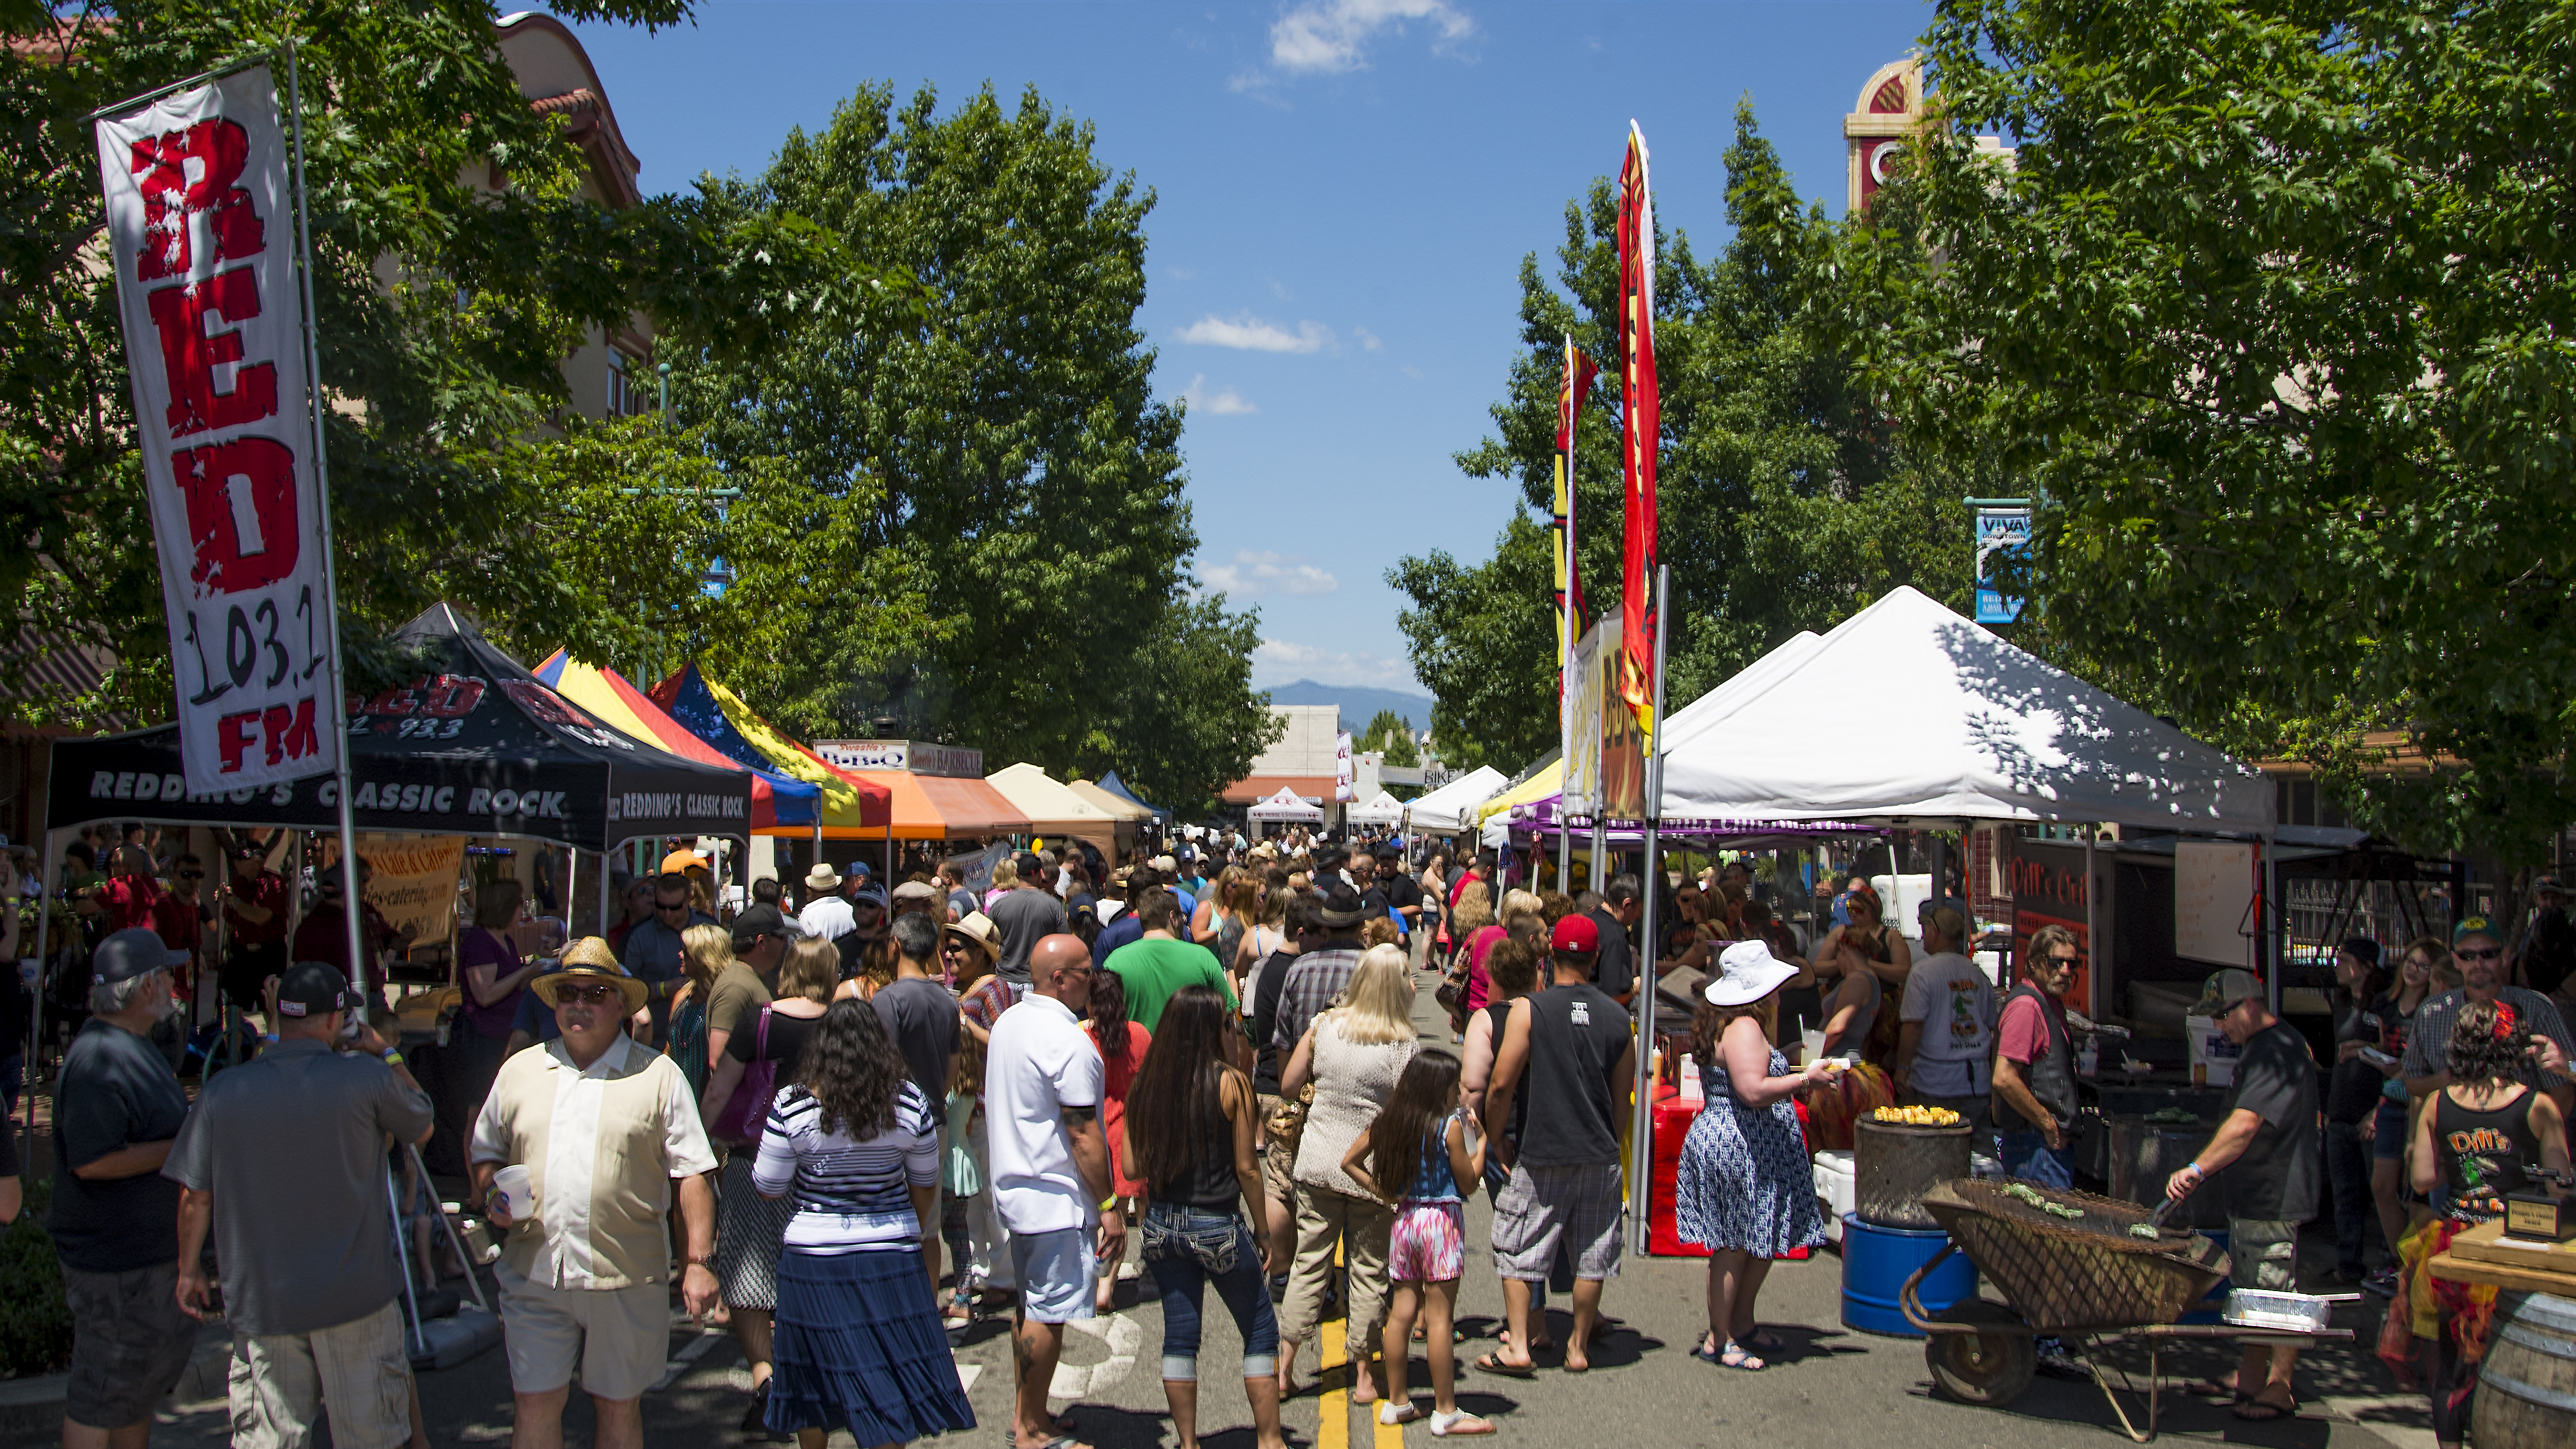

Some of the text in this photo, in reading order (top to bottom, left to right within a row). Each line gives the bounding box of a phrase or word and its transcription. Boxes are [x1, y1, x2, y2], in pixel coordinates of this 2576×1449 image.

[131, 116, 300, 599] RED
[184, 584, 325, 706] 103.1
[217, 694, 319, 775] FM
[937, 748, 981, 772] BARBECUE
[1425, 770, 1455, 785] BIKE
[318, 780, 454, 815] CASSIC
[468, 787, 566, 820] ROCK
[623, 792, 681, 820] REDDING'S
[687, 793, 719, 818] CLASSIC
[722, 795, 744, 819] ROCK
[2446, 1127, 2512, 1155] Dill's
